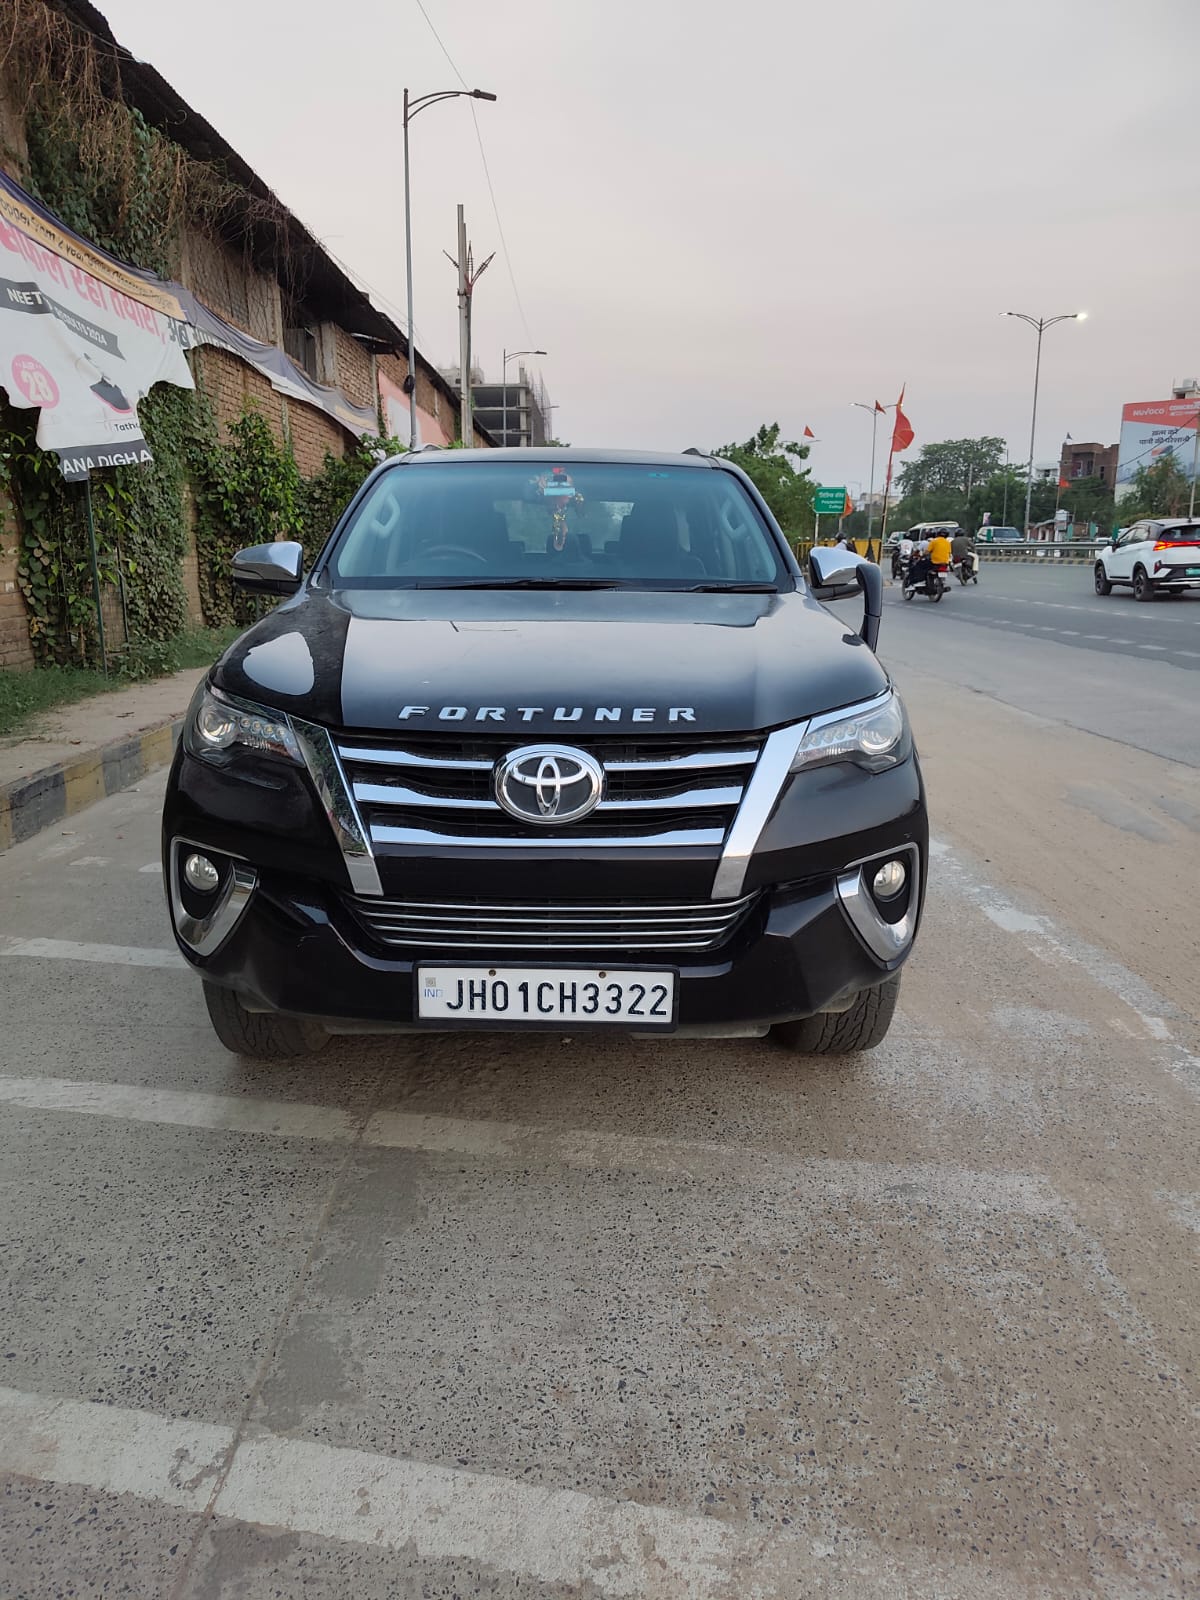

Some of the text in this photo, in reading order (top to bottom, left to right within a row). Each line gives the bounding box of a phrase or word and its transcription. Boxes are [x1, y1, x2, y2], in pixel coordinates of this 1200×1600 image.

[7, 287, 43, 306] NEET
[58, 449, 154, 475] ANA DIGHA
[398, 705, 697, 722] FORTUNER
[446, 979, 668, 1016] JH01CH3322
